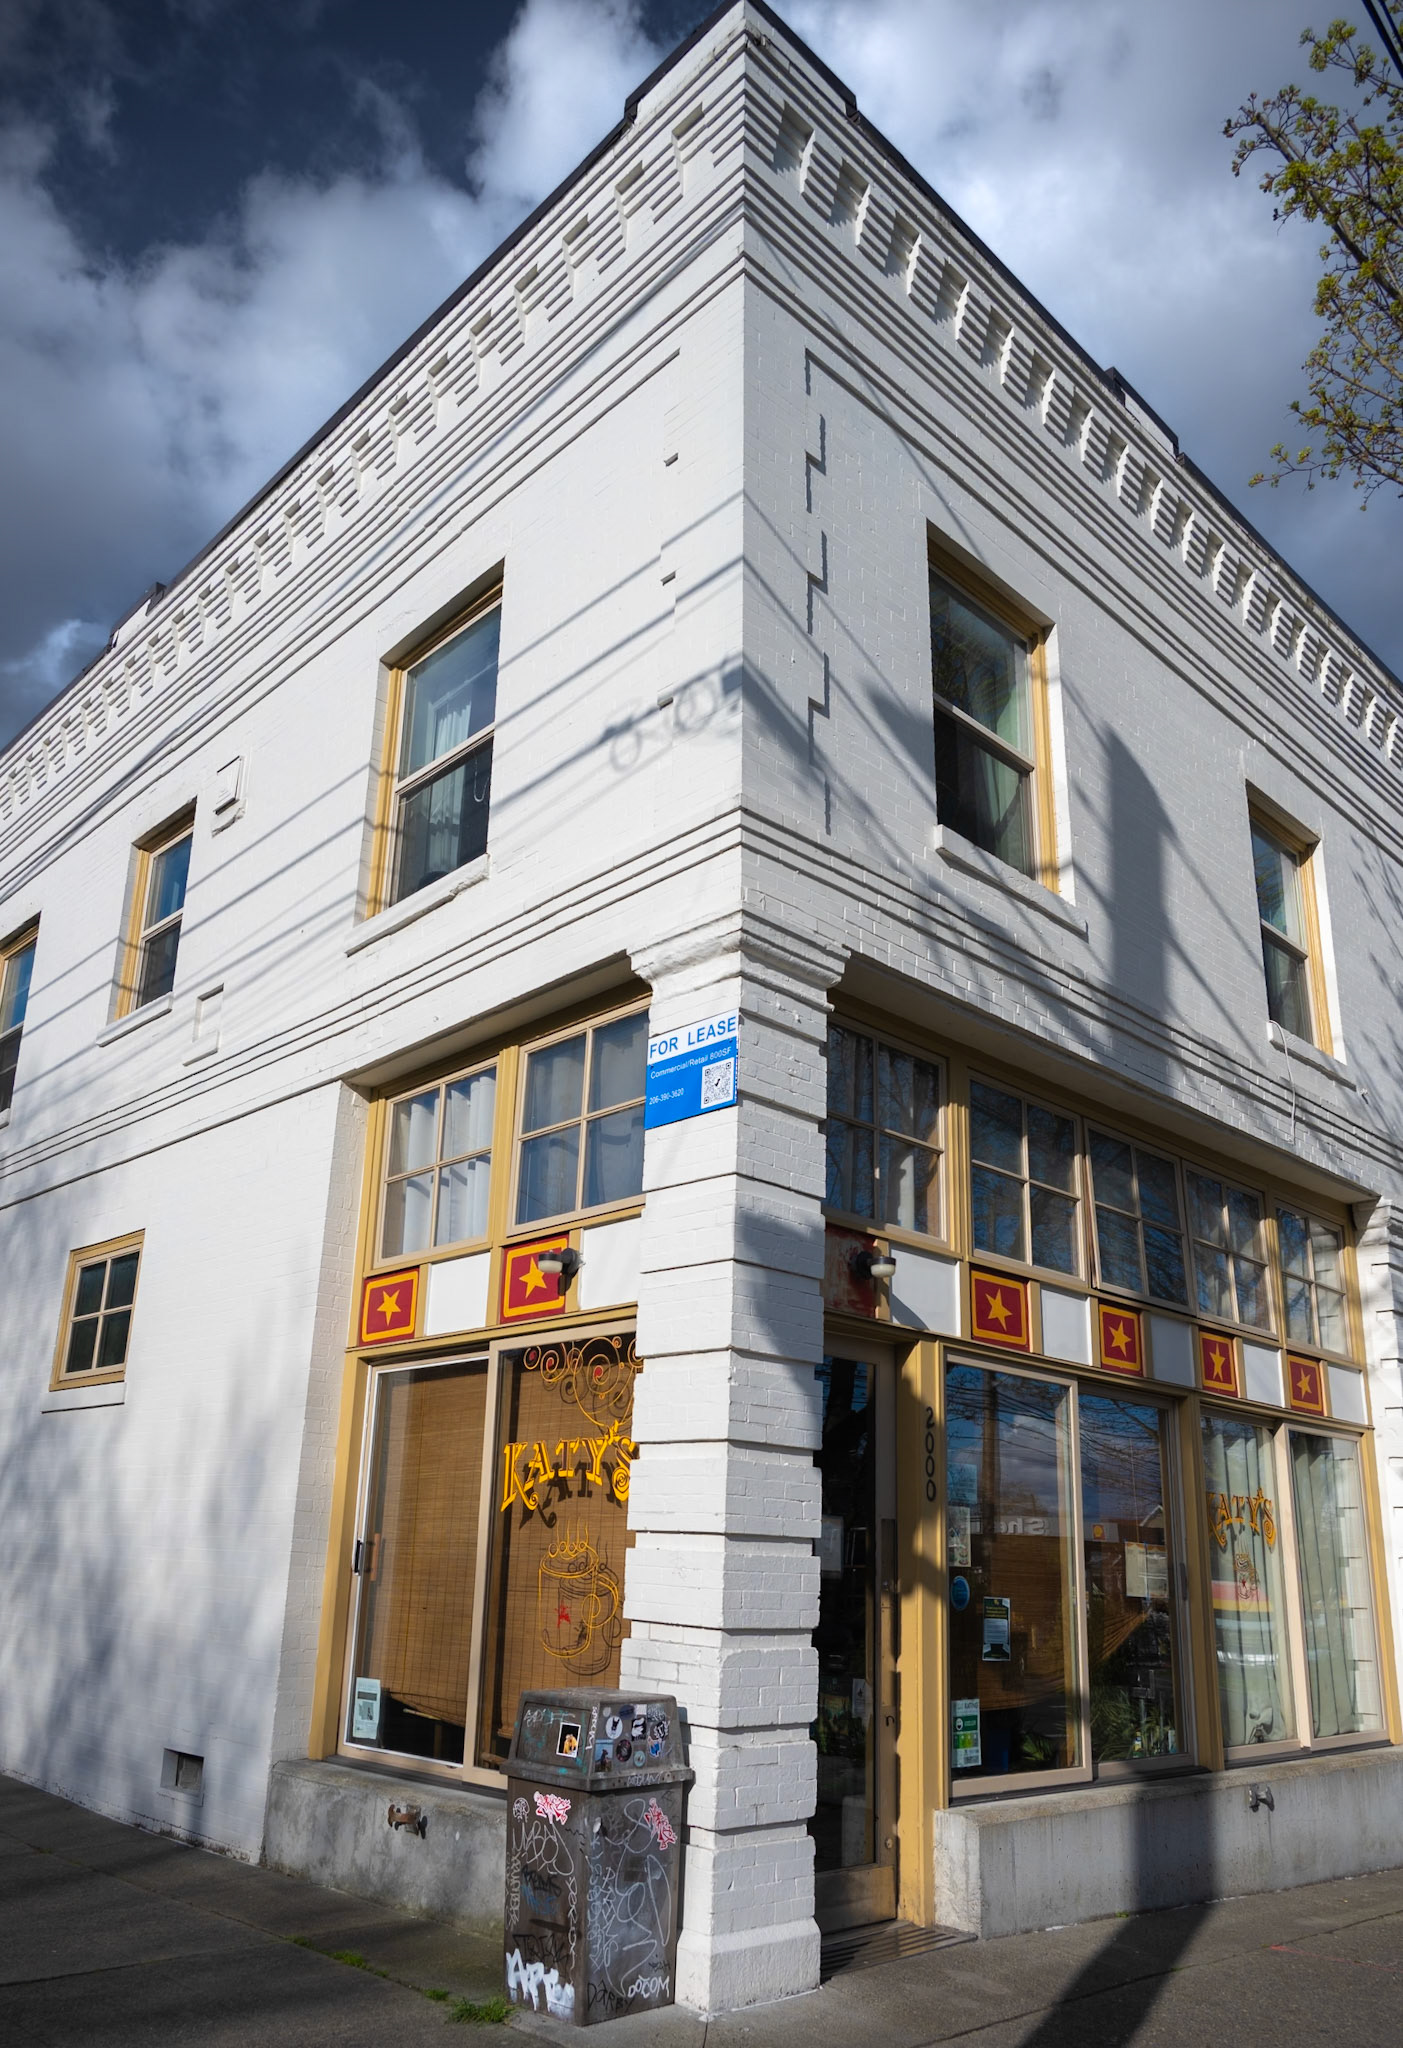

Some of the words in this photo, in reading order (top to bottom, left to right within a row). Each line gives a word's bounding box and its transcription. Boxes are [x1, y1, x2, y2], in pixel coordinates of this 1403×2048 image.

[650, 1036, 678, 1058] FOR
[688, 1016, 736, 1046] LEASE
[500, 1419, 639, 1512] KATY'S
[925, 1406, 937, 1502] 2000
